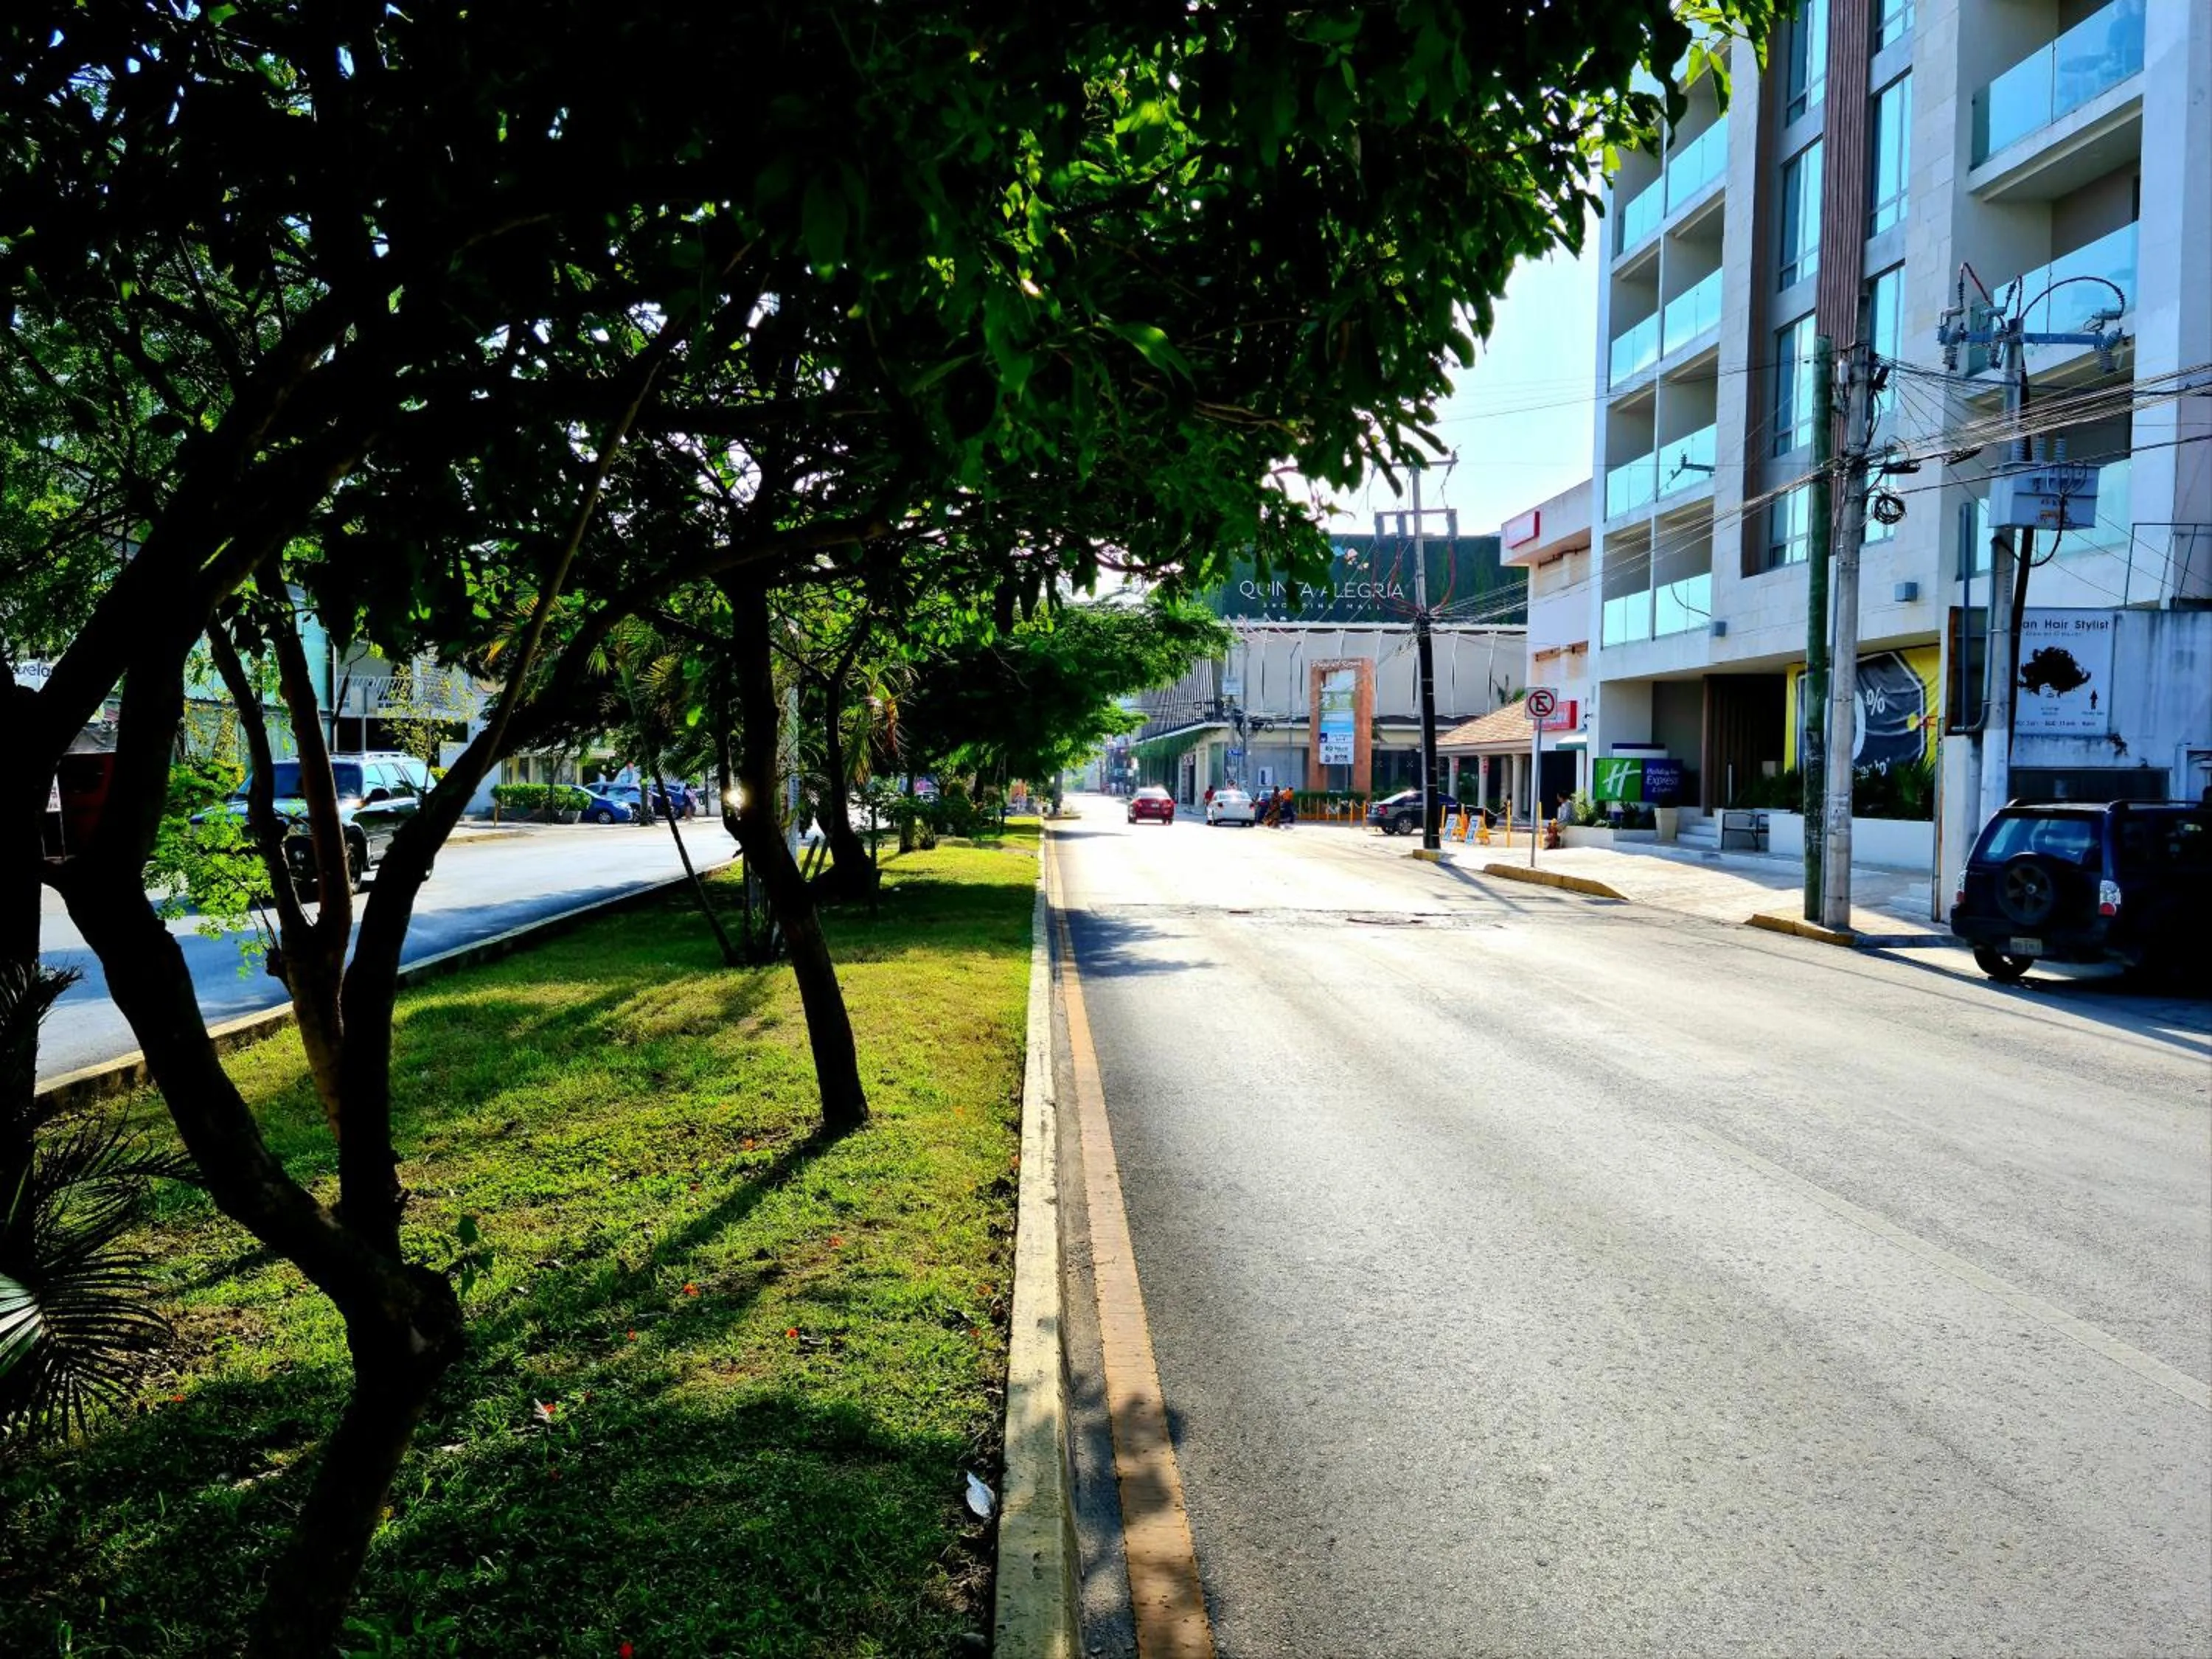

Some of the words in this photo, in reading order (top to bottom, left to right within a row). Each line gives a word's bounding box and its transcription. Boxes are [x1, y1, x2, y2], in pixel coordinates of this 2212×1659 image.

[1239, 580, 1315, 599] QUINA
[2045, 619, 2067, 629] Hair
[2075, 620, 2109, 632] Stylist
